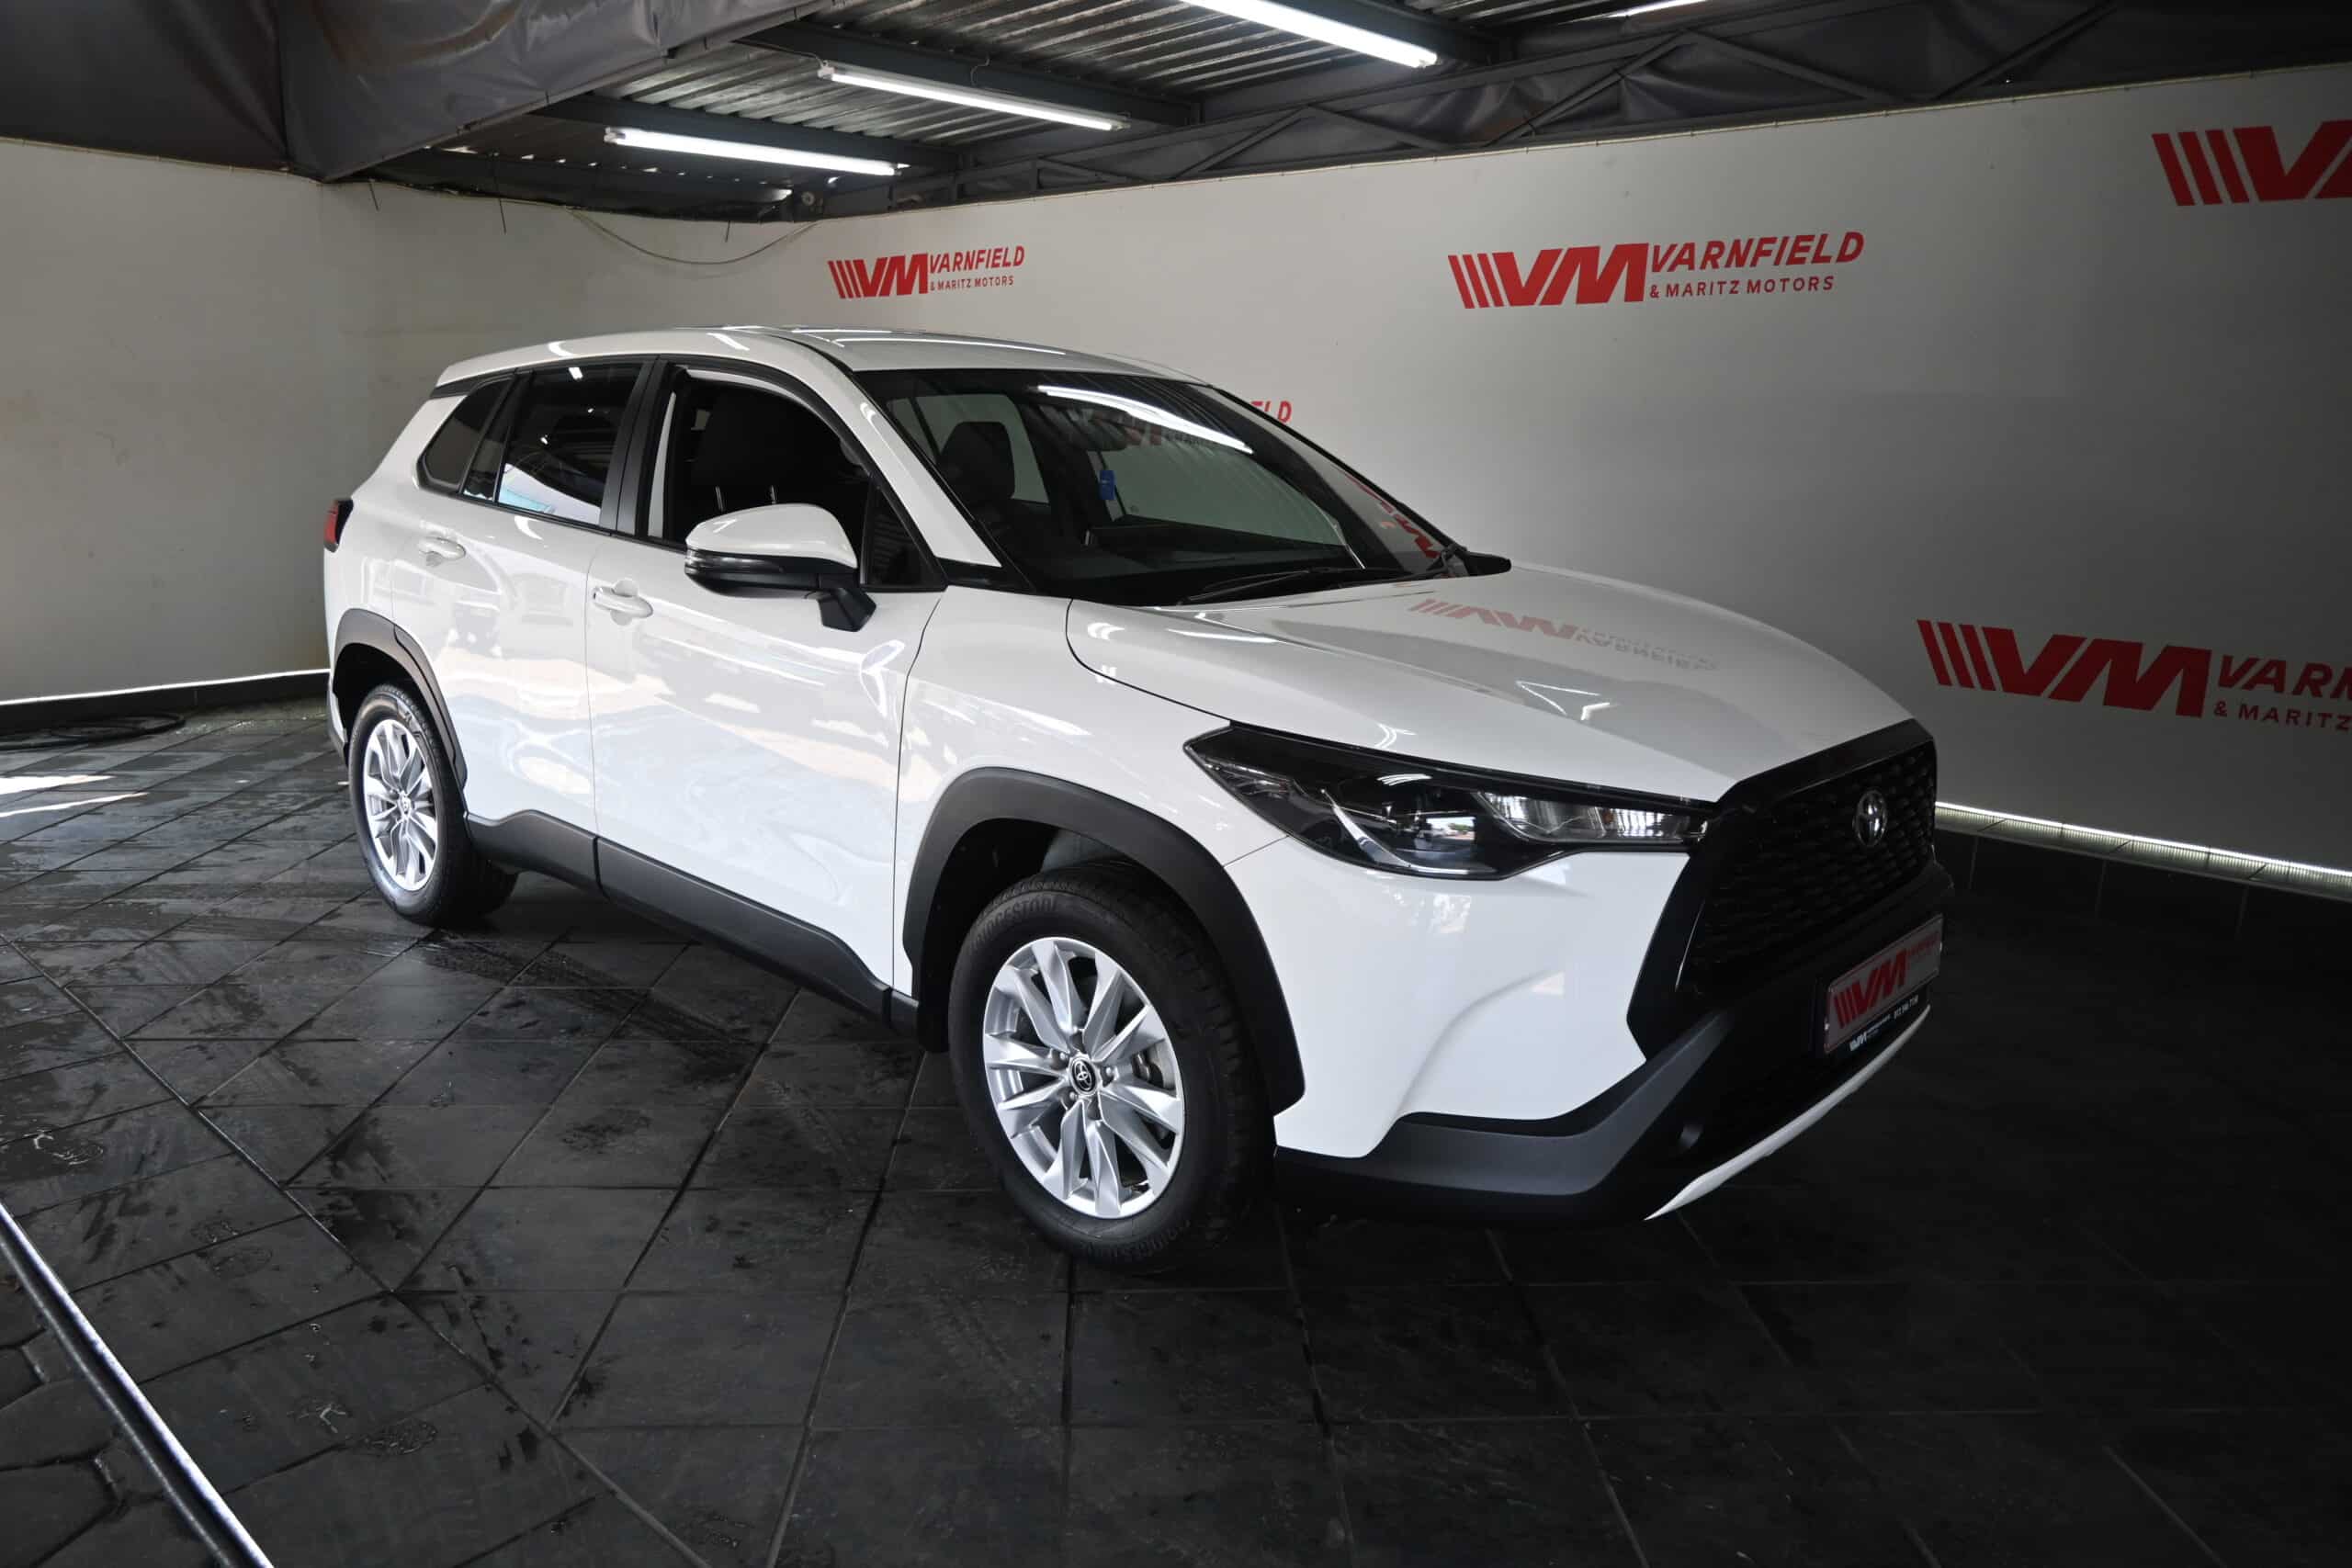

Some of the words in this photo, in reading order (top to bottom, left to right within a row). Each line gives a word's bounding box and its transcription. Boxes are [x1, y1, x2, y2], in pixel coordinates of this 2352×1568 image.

[2233, 119, 2352, 202] V
[930, 245, 1025, 273] VARNFIELD
[1651, 231, 1865, 273] VARNFIELD
[853, 253, 928, 298] VM
[930, 281, 935, 290] &
[937, 278, 971, 290] MARITZ
[974, 275, 1014, 288] MOTORS
[1492, 243, 1649, 307] VM
[1649, 284, 1659, 299] &
[1666, 280, 1740, 298] MARITZ
[1747, 276, 1834, 294] MOTORS
[1981, 626, 2212, 717] VM
[2213, 701, 2227, 716] &
[2238, 704, 2352, 732] MARITZ
